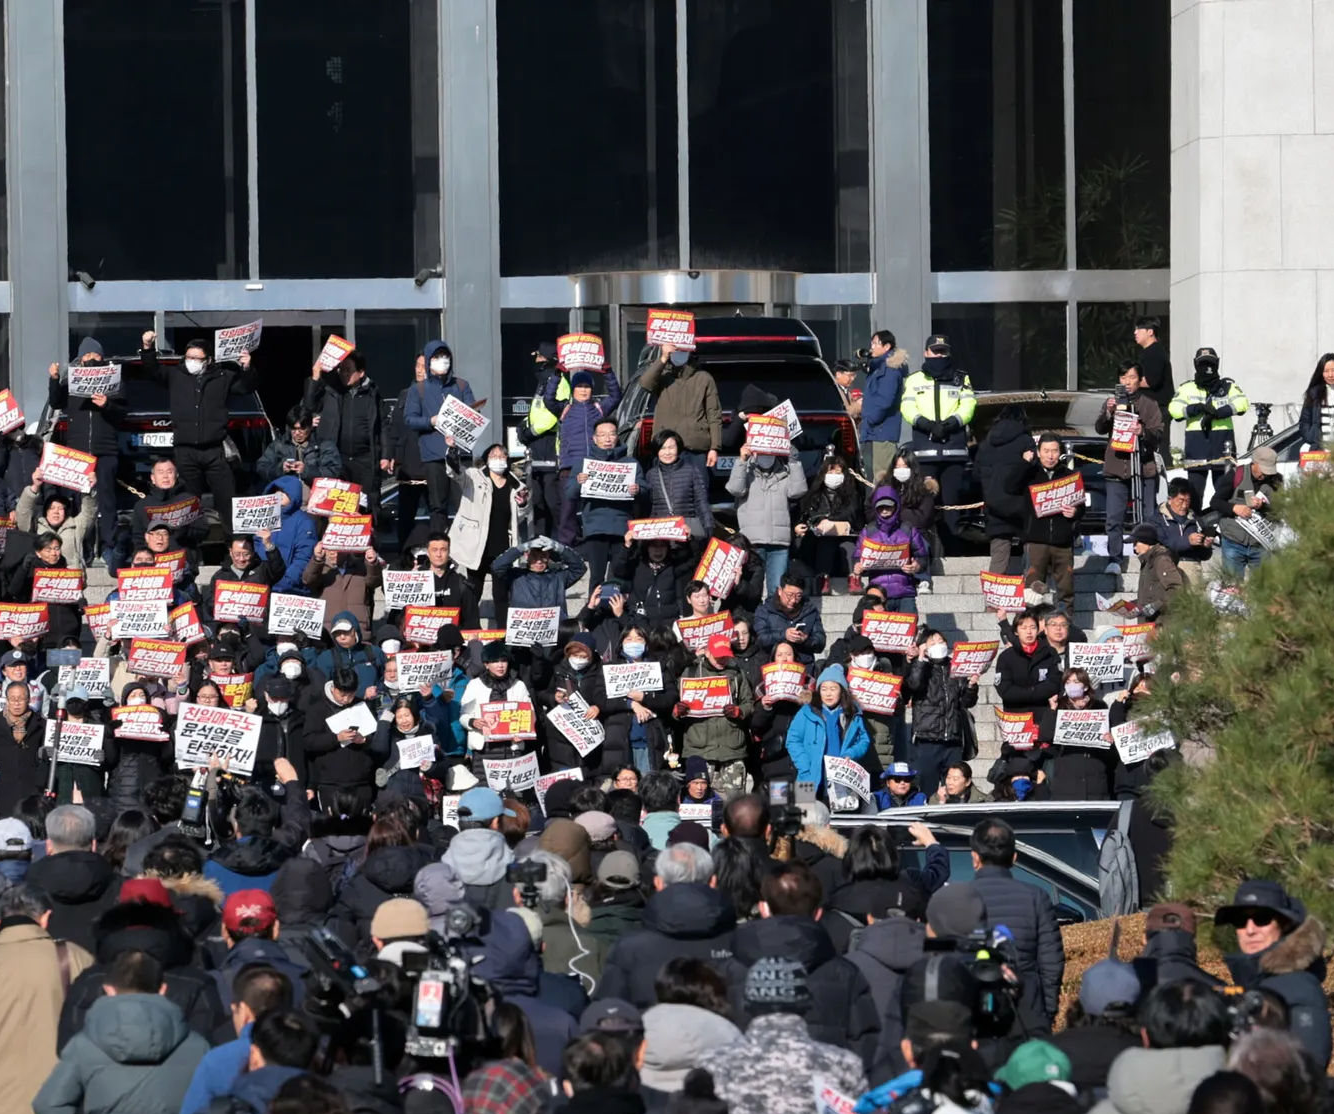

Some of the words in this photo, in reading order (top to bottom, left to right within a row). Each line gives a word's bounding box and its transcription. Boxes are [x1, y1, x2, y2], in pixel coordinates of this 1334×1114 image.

[650, 319, 690, 333] 윤석열을
[653, 331, 694, 344] 타도하자!
[560, 342, 600, 356] 윤석열을
[72, 367, 117, 377] 친일매국노
[71, 376, 112, 386] 윤석열을
[76, 383, 119, 394] 탄핵하자!
[447, 399, 485, 427] 친일매국노
[442, 408, 477, 433] 윤석열을
[587, 462, 633, 473] 친일매국노
[588, 471, 627, 483] 윤석열을
[327, 489, 360, 500] 윤석열
[1036, 482, 1076, 502] 윤석열을
[237, 497, 278, 508] 친일매국노
[235, 506, 274, 519] 윤석열을
[241, 514, 279, 528] 탄핵하자!
[36, 578, 79, 589] 윤석열을
[121, 578, 165, 589] 윤석열을
[387, 573, 429, 582] 친일매국노
[387, 582, 424, 592] 윤석열을
[983, 581, 1017, 596] 윤석열을
[38, 589, 82, 600] 타도하자
[125, 589, 171, 600] 타도하자!
[218, 590, 261, 605] 윤석열을
[392, 592, 432, 603] 탄핵하자!
[115, 602, 162, 612] 친일매국노
[275, 596, 321, 610] 친일매국노
[221, 601, 264, 618] 타도하자!
[274, 607, 315, 619] 윤석열을
[511, 609, 556, 619] 친일매국노
[117, 613, 155, 622] 윤석열을
[2, 622, 48, 634] 타도하자!
[120, 622, 165, 632] 탄핵하자!
[278, 618, 321, 631] 탄핵하자!
[510, 619, 550, 630] 윤석열을
[683, 620, 724, 638] 윤석열을
[865, 621, 908, 634] 윤석열을
[516, 629, 556, 640] 탄핵하자!
[1073, 645, 1120, 654] 친일매국노
[401, 654, 448, 664] 친일매국노
[1073, 655, 1114, 666] 윤석열을
[401, 663, 444, 675] 윤석열을
[608, 665, 655, 674] 친일매국노
[609, 670, 650, 683] 윤석열을
[615, 679, 660, 692] 탄핵하자!
[849, 676, 894, 695] 윤석열을
[682, 690, 708, 701] 즉각
[184, 707, 256, 731] 친일매국노
[499, 710, 532, 723] 윤석열
[1062, 712, 1108, 721] 친일매국노
[508, 721, 531, 733] 탄핵
[1060, 721, 1102, 731] 윤석열을
[181, 723, 245, 745] 윤석열을
[187, 740, 254, 764] 탄핵하자!
[488, 769, 512, 780] 즉각
[511, 768, 536, 785] 체포!
